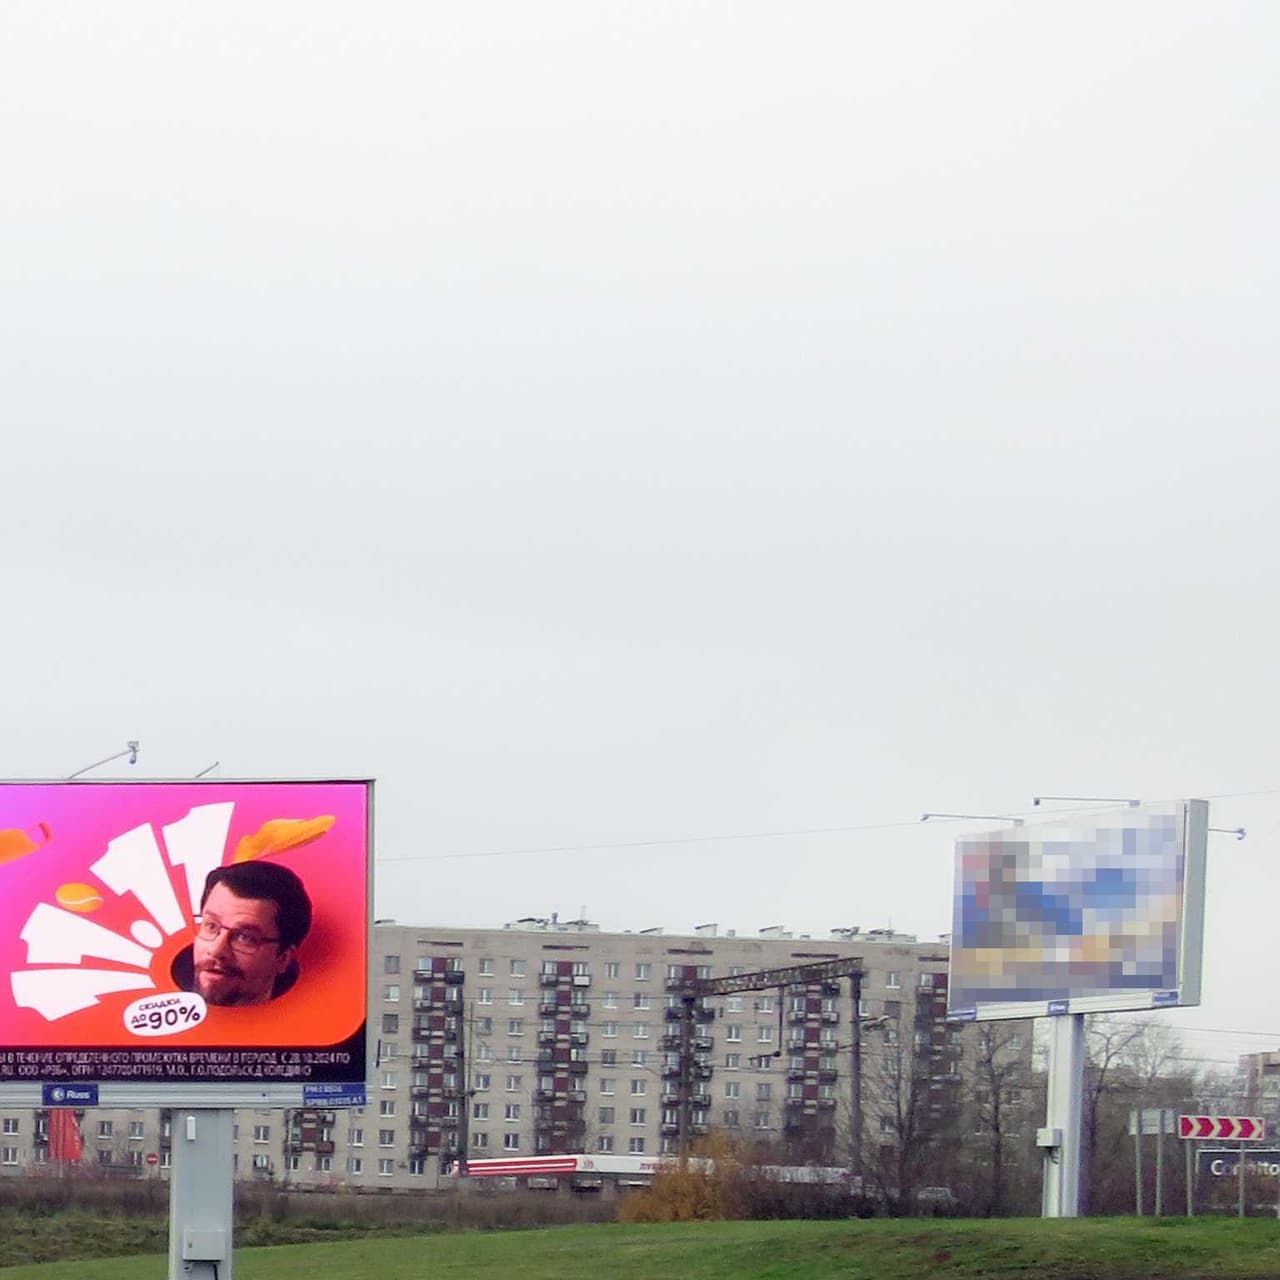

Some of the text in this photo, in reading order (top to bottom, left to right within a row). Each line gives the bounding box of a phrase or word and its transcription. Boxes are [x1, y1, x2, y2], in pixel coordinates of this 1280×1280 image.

[7, 1053, 14, 1064] В
[233, 1053, 239, 1064] В
[281, 1053, 287, 1064] С
[336, 1053, 350, 1064] ПО
[18, 1065, 39, 1076] ООО
